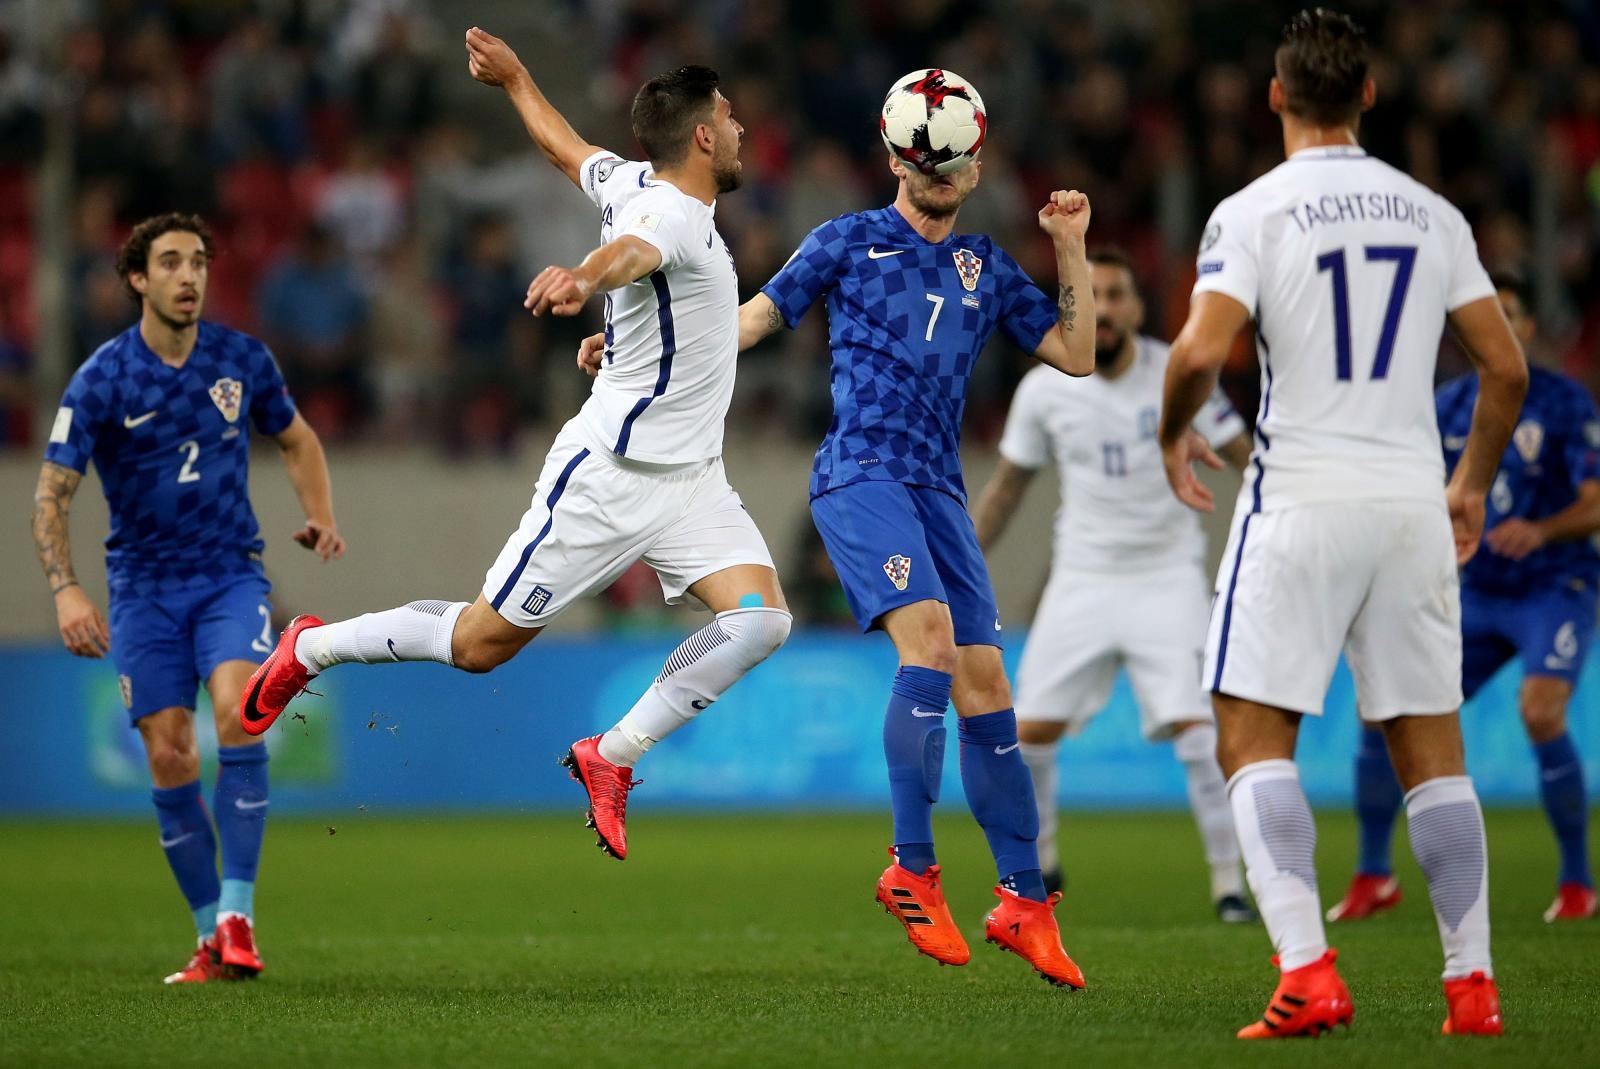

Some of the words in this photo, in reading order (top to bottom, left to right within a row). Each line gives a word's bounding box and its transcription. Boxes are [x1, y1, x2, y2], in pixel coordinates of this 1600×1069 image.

[1287, 191, 1430, 234] TACHTSIDIS
[925, 293, 944, 341] 7
[1317, 245, 1417, 380] 17
[179, 441, 200, 483] 2
[1491, 470, 1512, 514] 6
[257, 604, 273, 647] 2
[1554, 622, 1577, 659] 6
